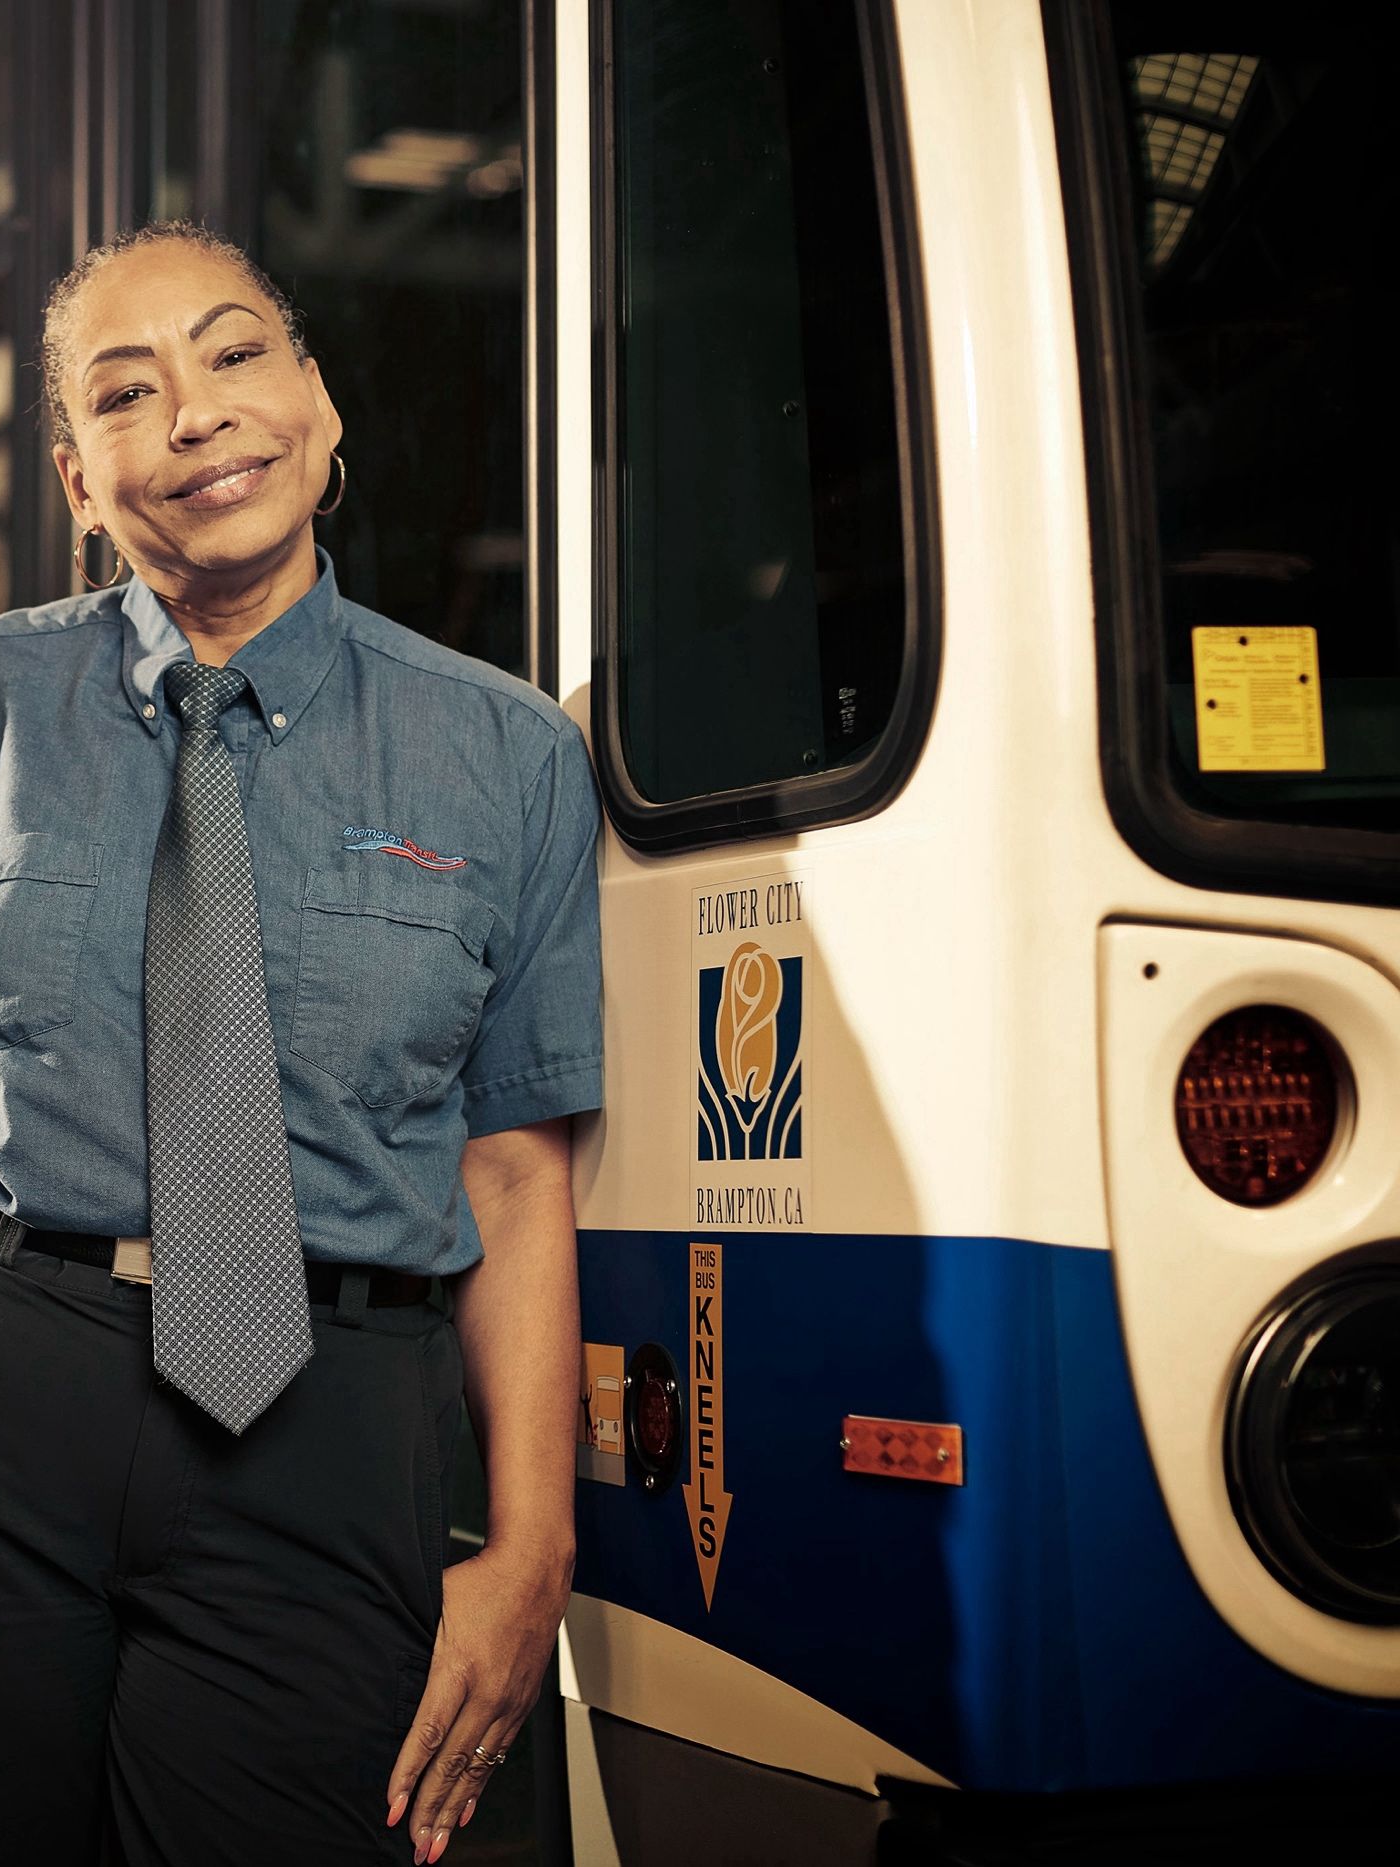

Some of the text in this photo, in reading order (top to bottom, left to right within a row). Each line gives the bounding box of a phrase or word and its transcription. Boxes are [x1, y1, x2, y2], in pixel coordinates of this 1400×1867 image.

[343, 826, 439, 861] Brampton Transit
[698, 880, 804, 936] FLOWER CITY
[696, 1187, 804, 1225] BRAMPTON.CA
[694, 1250, 716, 1268] THIS
[695, 1272, 715, 1290] BUS
[695, 1295, 717, 1559] KNEELS
